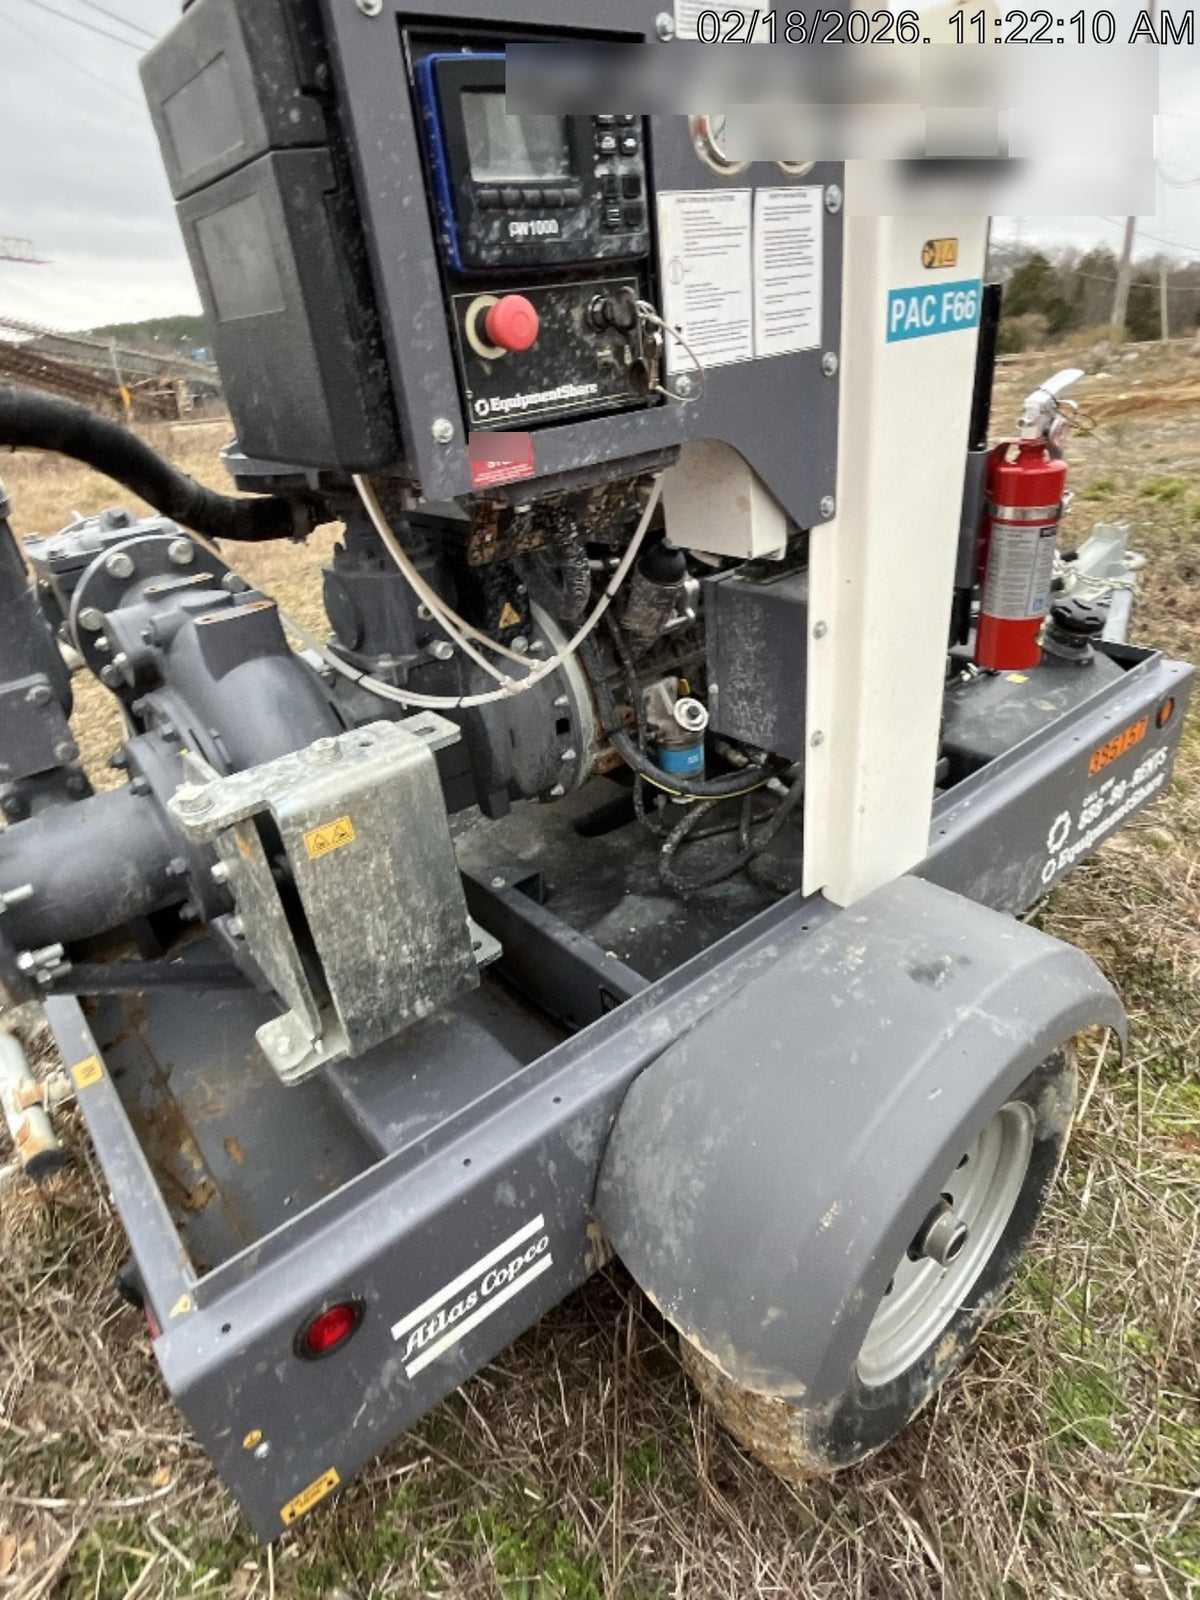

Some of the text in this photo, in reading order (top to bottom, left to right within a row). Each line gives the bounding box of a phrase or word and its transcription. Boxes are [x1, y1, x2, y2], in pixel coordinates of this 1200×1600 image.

[891, 289, 978, 333] PAC F66
[489, 383, 598, 413] EquipmentShare
[401, 1235, 549, 1362] Atlas Copco
